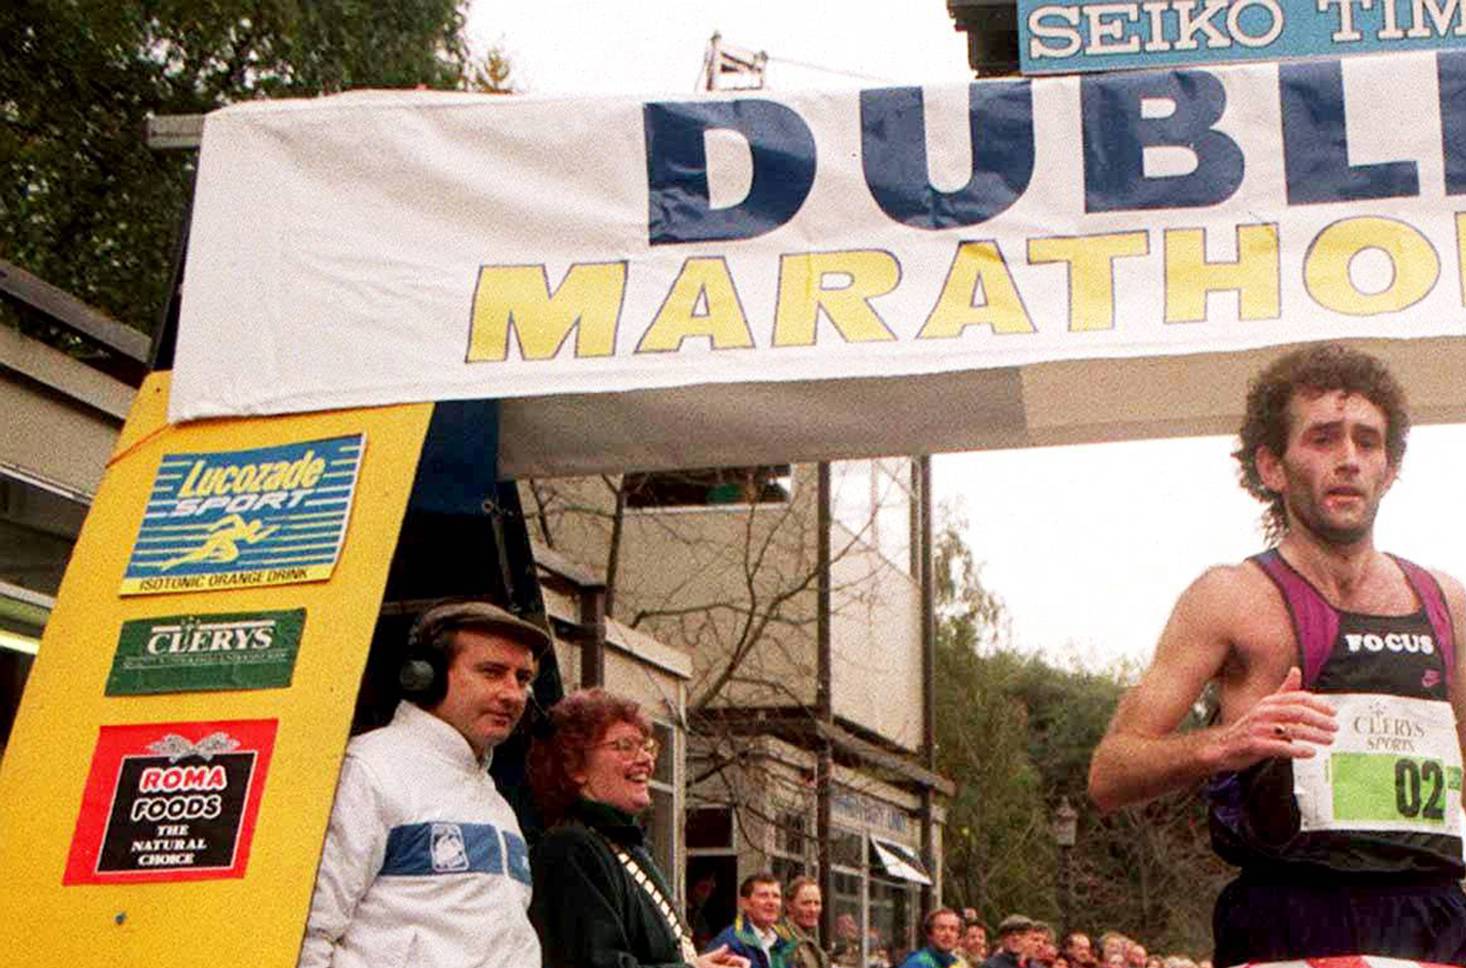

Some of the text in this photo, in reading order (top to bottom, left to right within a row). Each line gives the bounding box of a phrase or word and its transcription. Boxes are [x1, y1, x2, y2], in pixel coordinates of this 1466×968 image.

[1027, 0, 1285, 59] SEIKO
[177, 449, 326, 498] Lucozade
[170, 488, 314, 518] SPORT
[139, 568, 309, 591] ISOTONIC ORANGE DRINK
[147, 626, 276, 656] CLERYS
[1344, 632, 1435, 655] FOCUS
[1353, 715, 1426, 738] CLERYS
[138, 765, 228, 794] ROMA
[1394, 758, 1445, 820] 02
[130, 794, 222, 822] FOODS
[156, 824, 189, 837] THE
[131, 838, 208, 853] NATURAL
[137, 853, 195, 866] CHOICE
